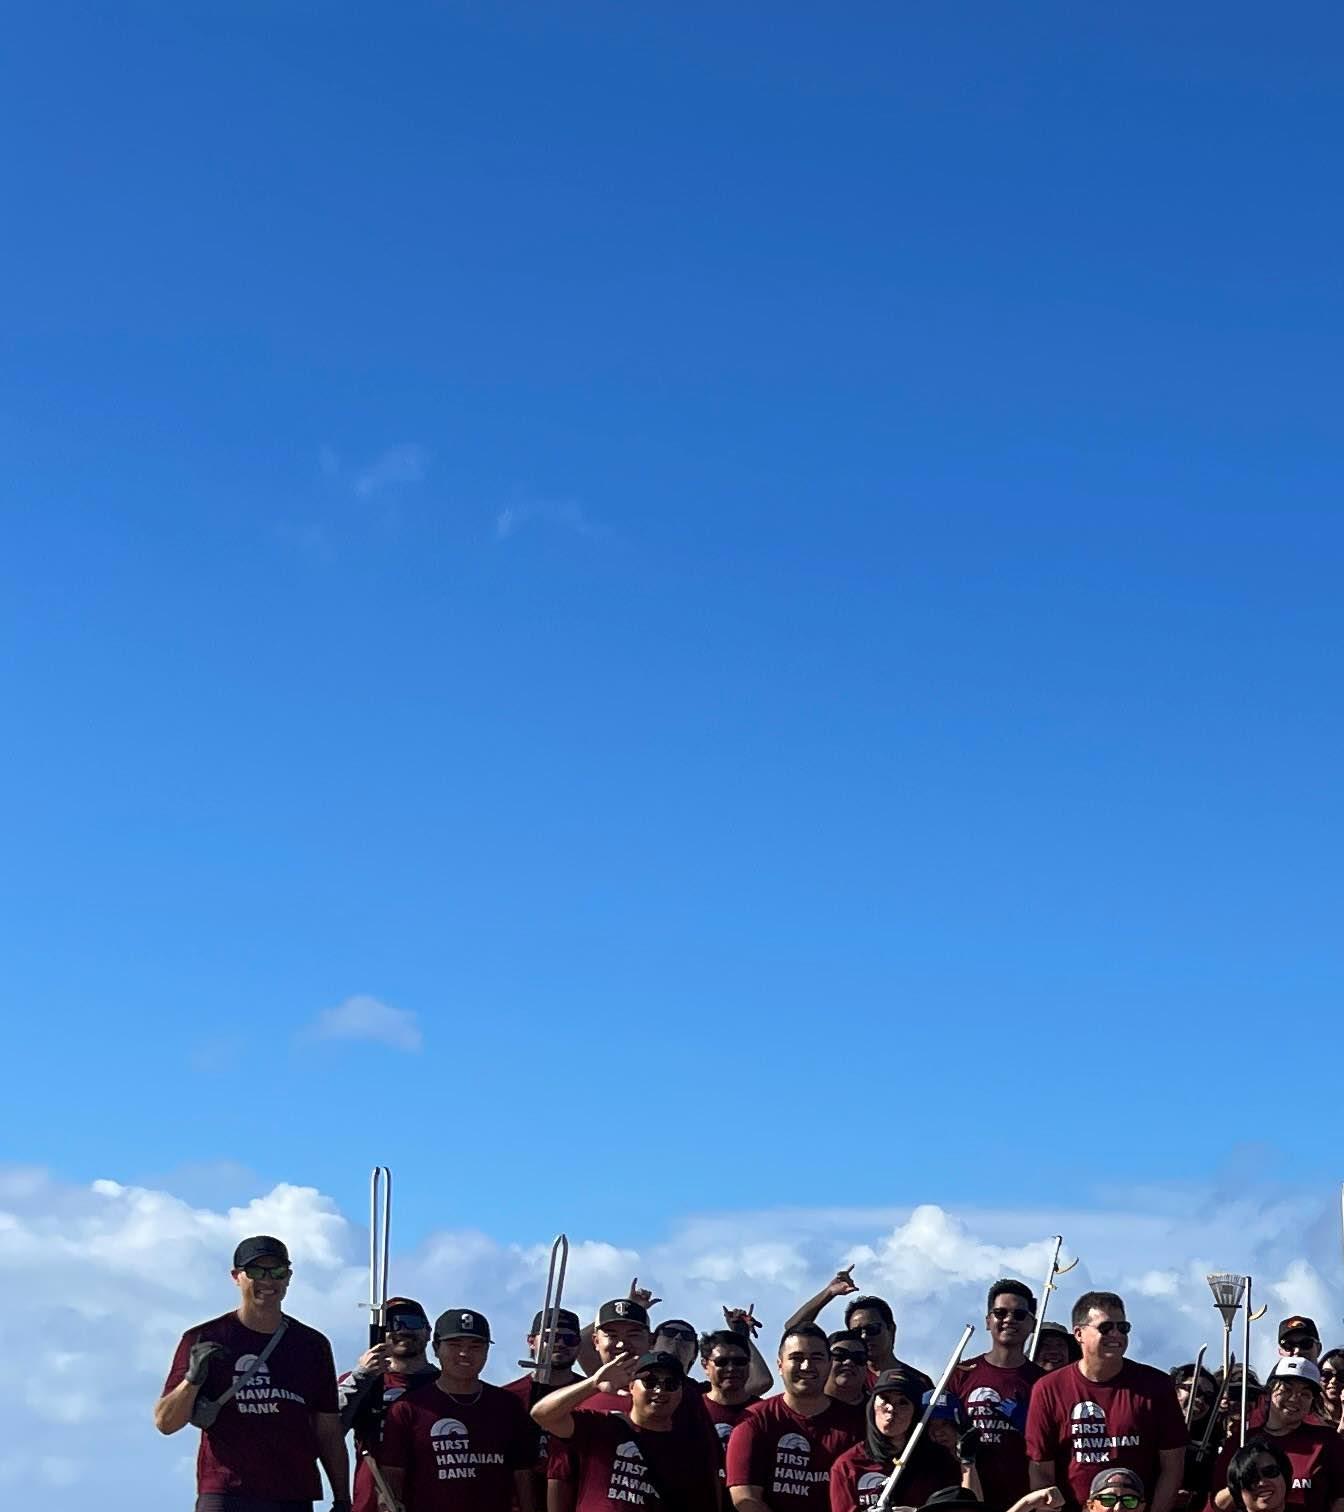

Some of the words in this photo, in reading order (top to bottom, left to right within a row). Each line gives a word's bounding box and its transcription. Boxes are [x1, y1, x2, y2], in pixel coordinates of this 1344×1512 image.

[238, 1402, 280, 1415] BANK
[1071, 1423, 1106, 1435] FIRST
[432, 1439, 470, 1452] FIRST
[1072, 1435, 1140, 1449] HAWAIIAN
[436, 1452, 505, 1466] HAWAIIAN
[776, 1452, 810, 1467] FIRST
[438, 1467, 477, 1480] BANK
[613, 1459, 649, 1477] FIRST
[775, 1467, 830, 1482] HAWAIIA
[608, 1487, 645, 1505] BANK
[773, 1481, 810, 1497] BANK
